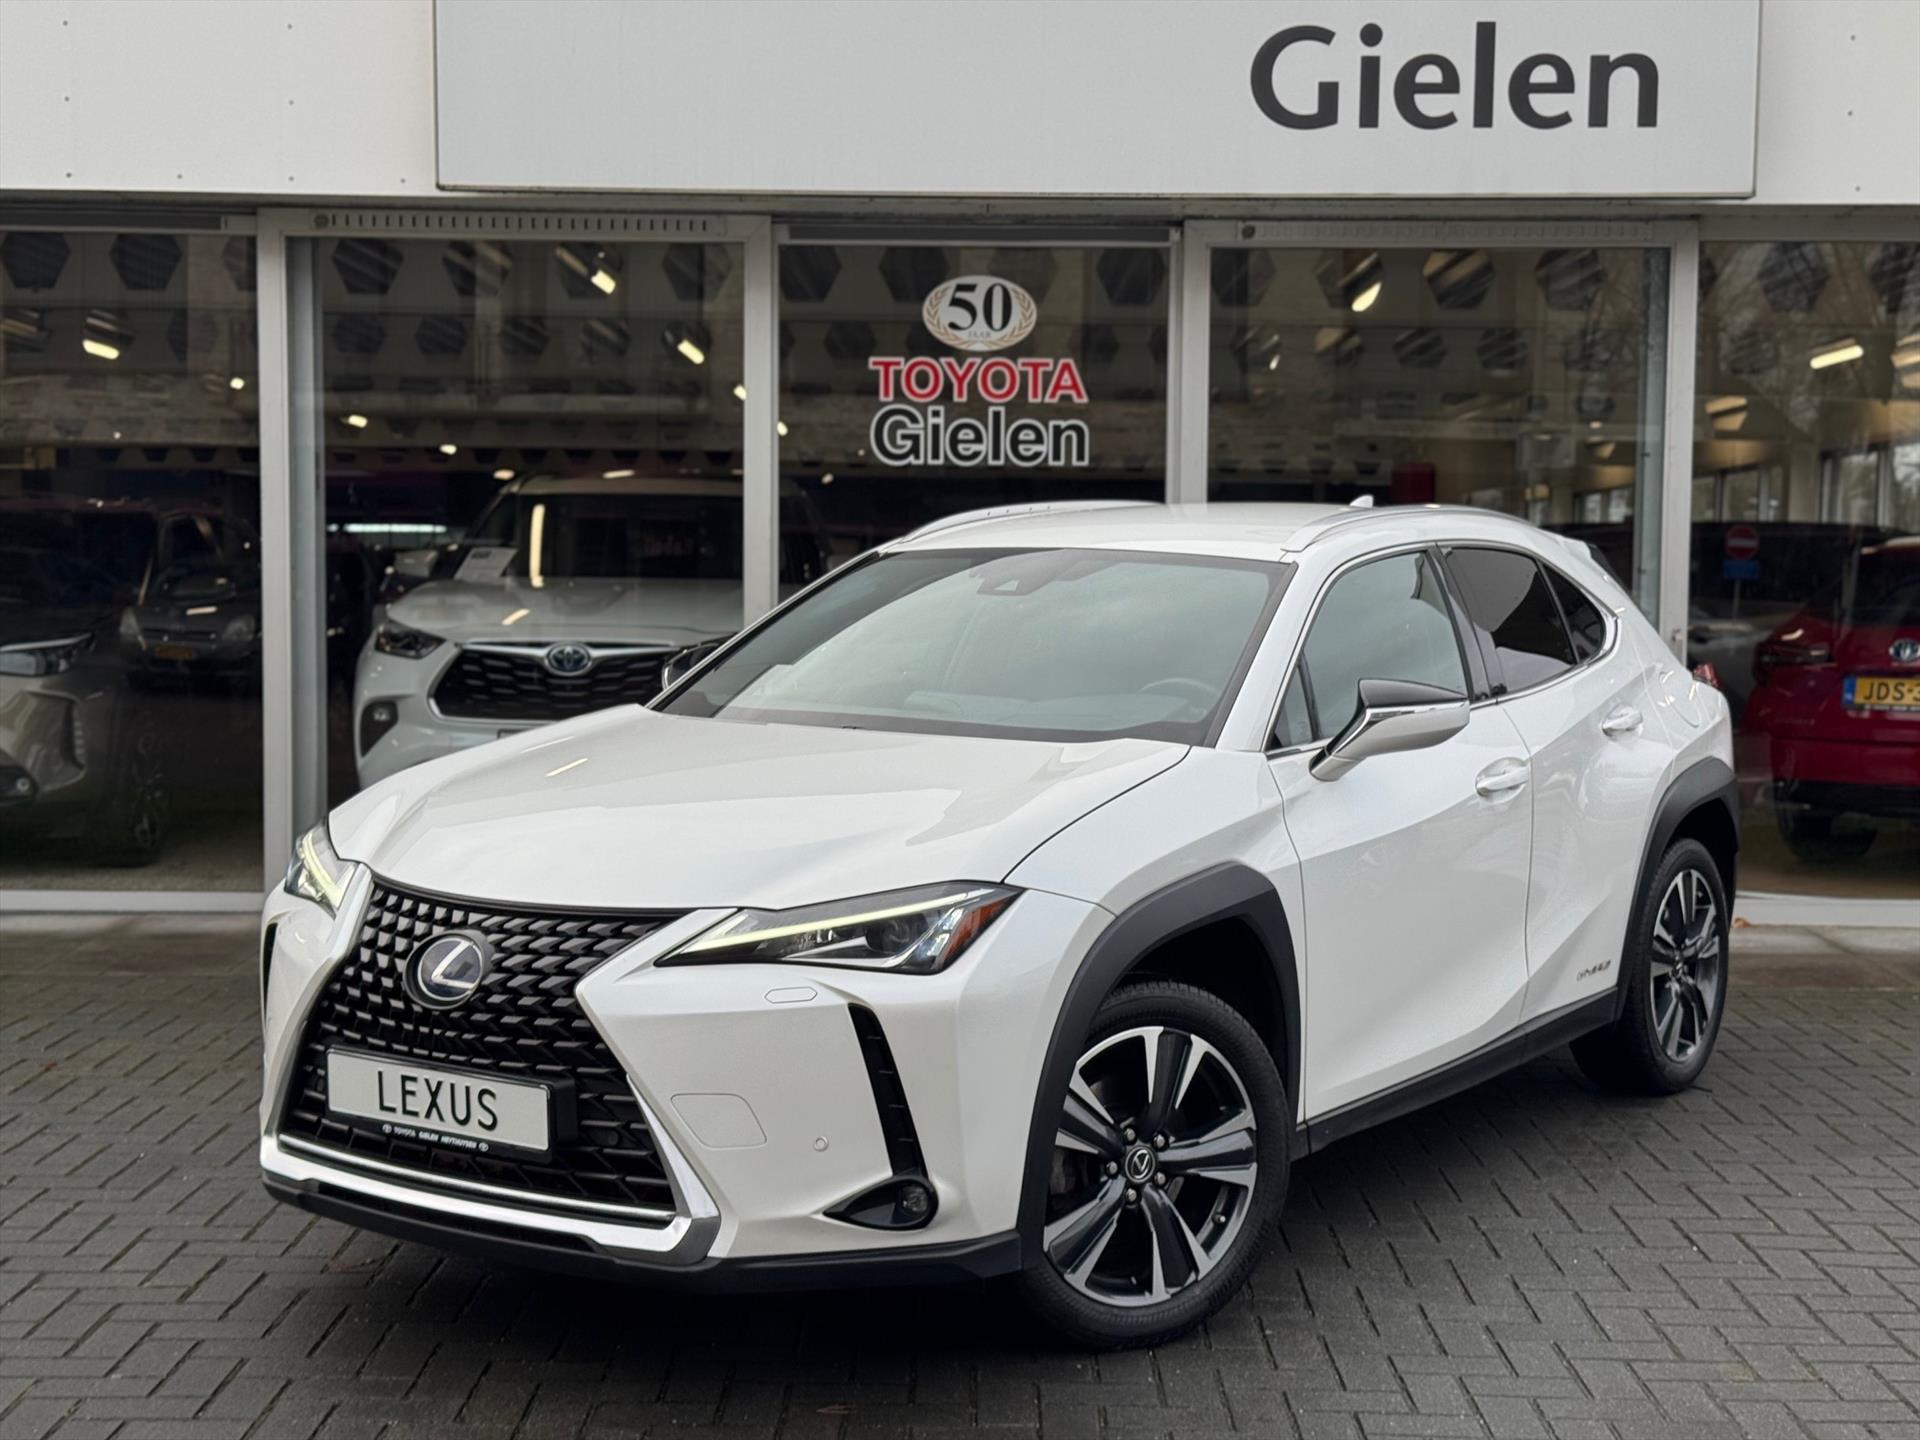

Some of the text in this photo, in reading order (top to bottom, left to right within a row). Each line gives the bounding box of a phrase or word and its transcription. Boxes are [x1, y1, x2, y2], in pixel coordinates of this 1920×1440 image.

[1250, 21, 1659, 130] Gielen
[948, 283, 1012, 331] 50
[868, 357, 1089, 403] TOYOTA
[870, 404, 1090, 467] Gielen
[377, 1070, 498, 1131] LEXUS
